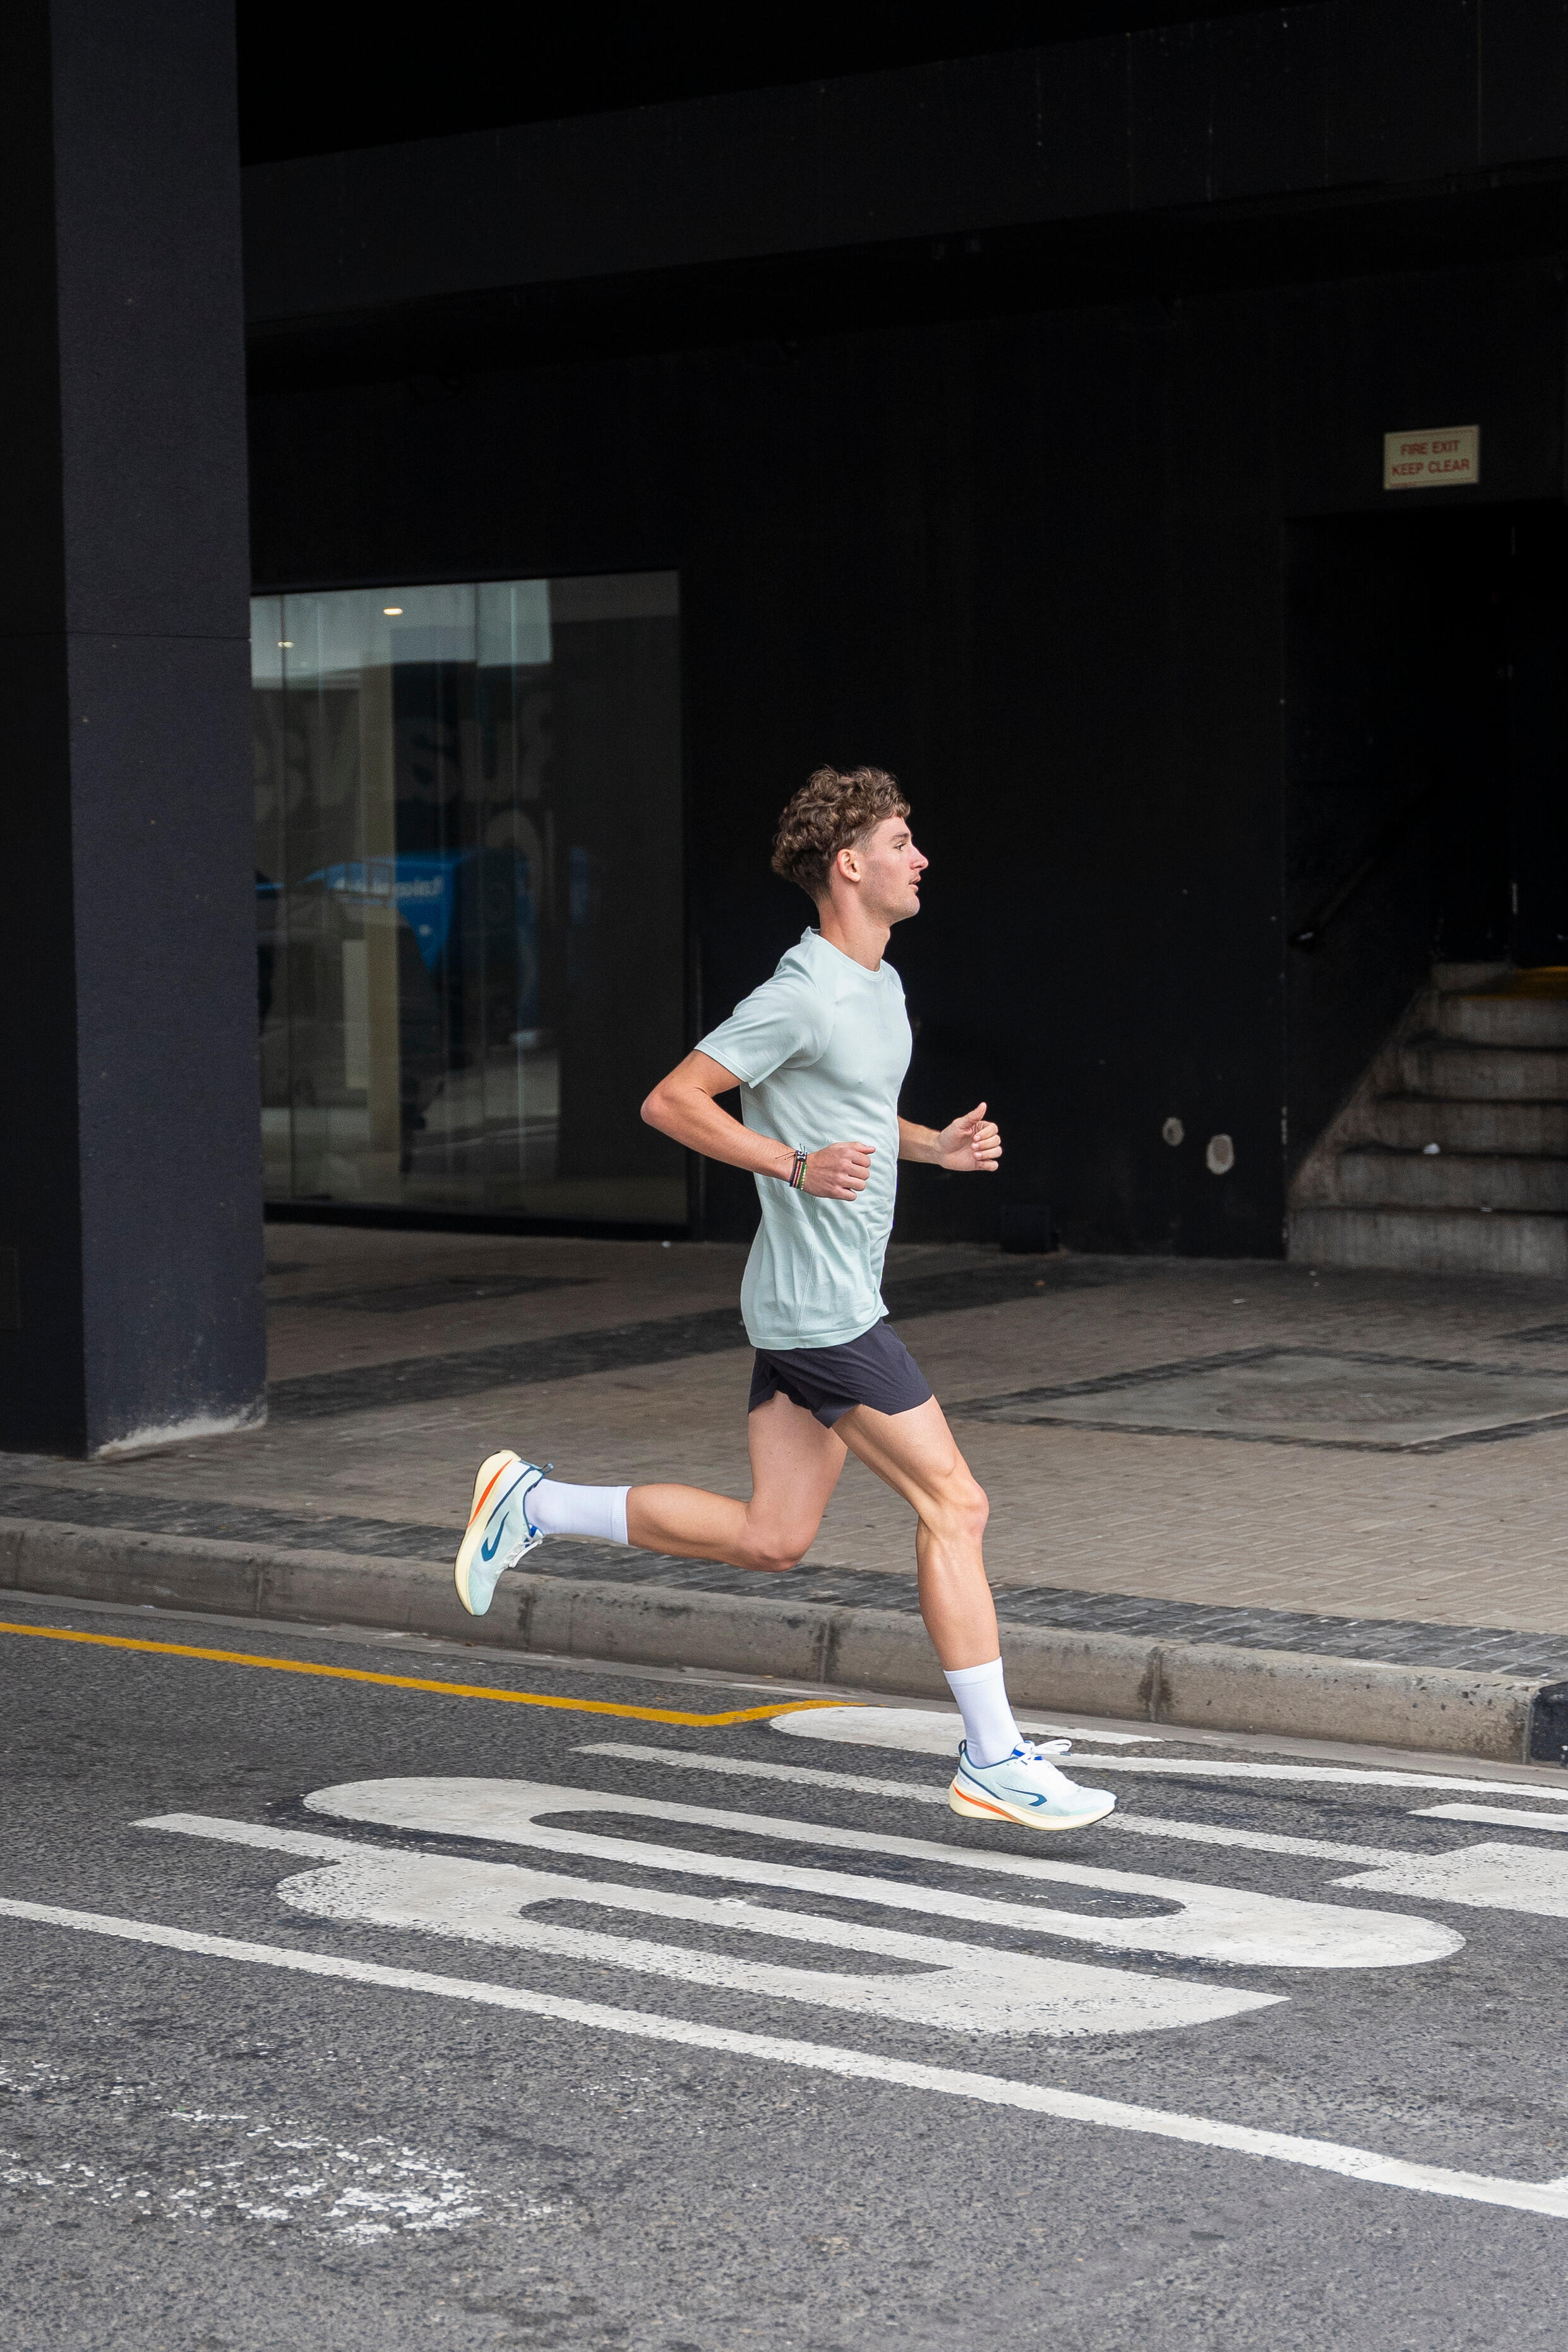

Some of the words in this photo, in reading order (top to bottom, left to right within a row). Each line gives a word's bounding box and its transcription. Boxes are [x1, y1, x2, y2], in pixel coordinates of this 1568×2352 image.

[1400, 442, 1427, 455] FIRE
[1432, 440, 1460, 454] EXIT
[1392, 462, 1423, 476] KEEP
[1428, 458, 1470, 474] CLEAR
